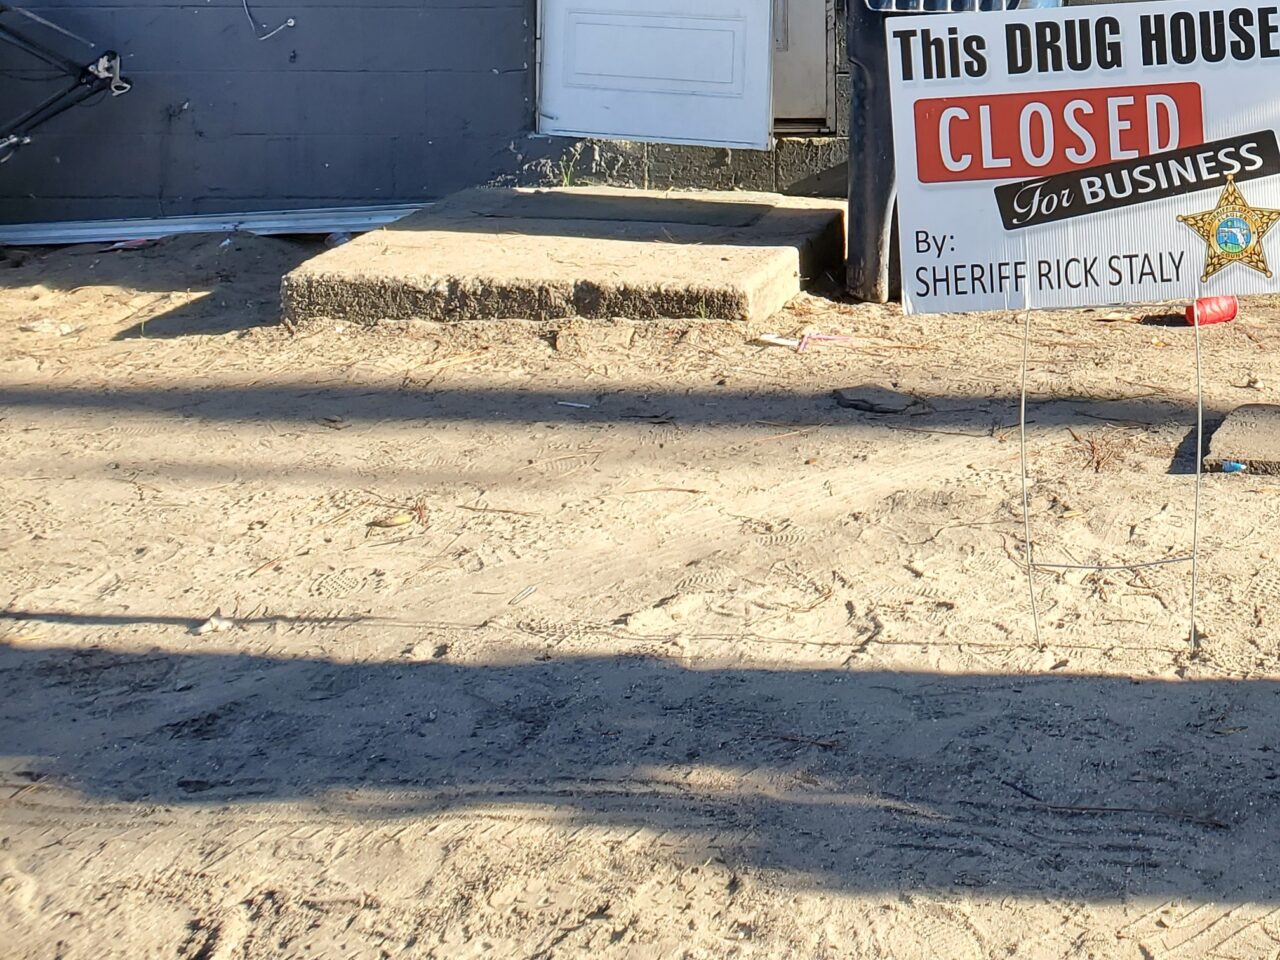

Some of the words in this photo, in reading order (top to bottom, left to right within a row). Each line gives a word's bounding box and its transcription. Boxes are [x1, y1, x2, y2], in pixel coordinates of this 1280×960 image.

[893, 27, 988, 81] This
[1005, 16, 1122, 74] DRUG
[1140, 6, 1280, 66] HOUSE
[938, 94, 1180, 172] CLOSED
[1012, 177, 1075, 224] For
[1080, 142, 1263, 205] BUSINESS
[915, 230, 955, 258] By:
[916, 261, 1026, 297] SHERIFF
[1038, 256, 1100, 291] RICK
[1108, 251, 1185, 286] STALY
